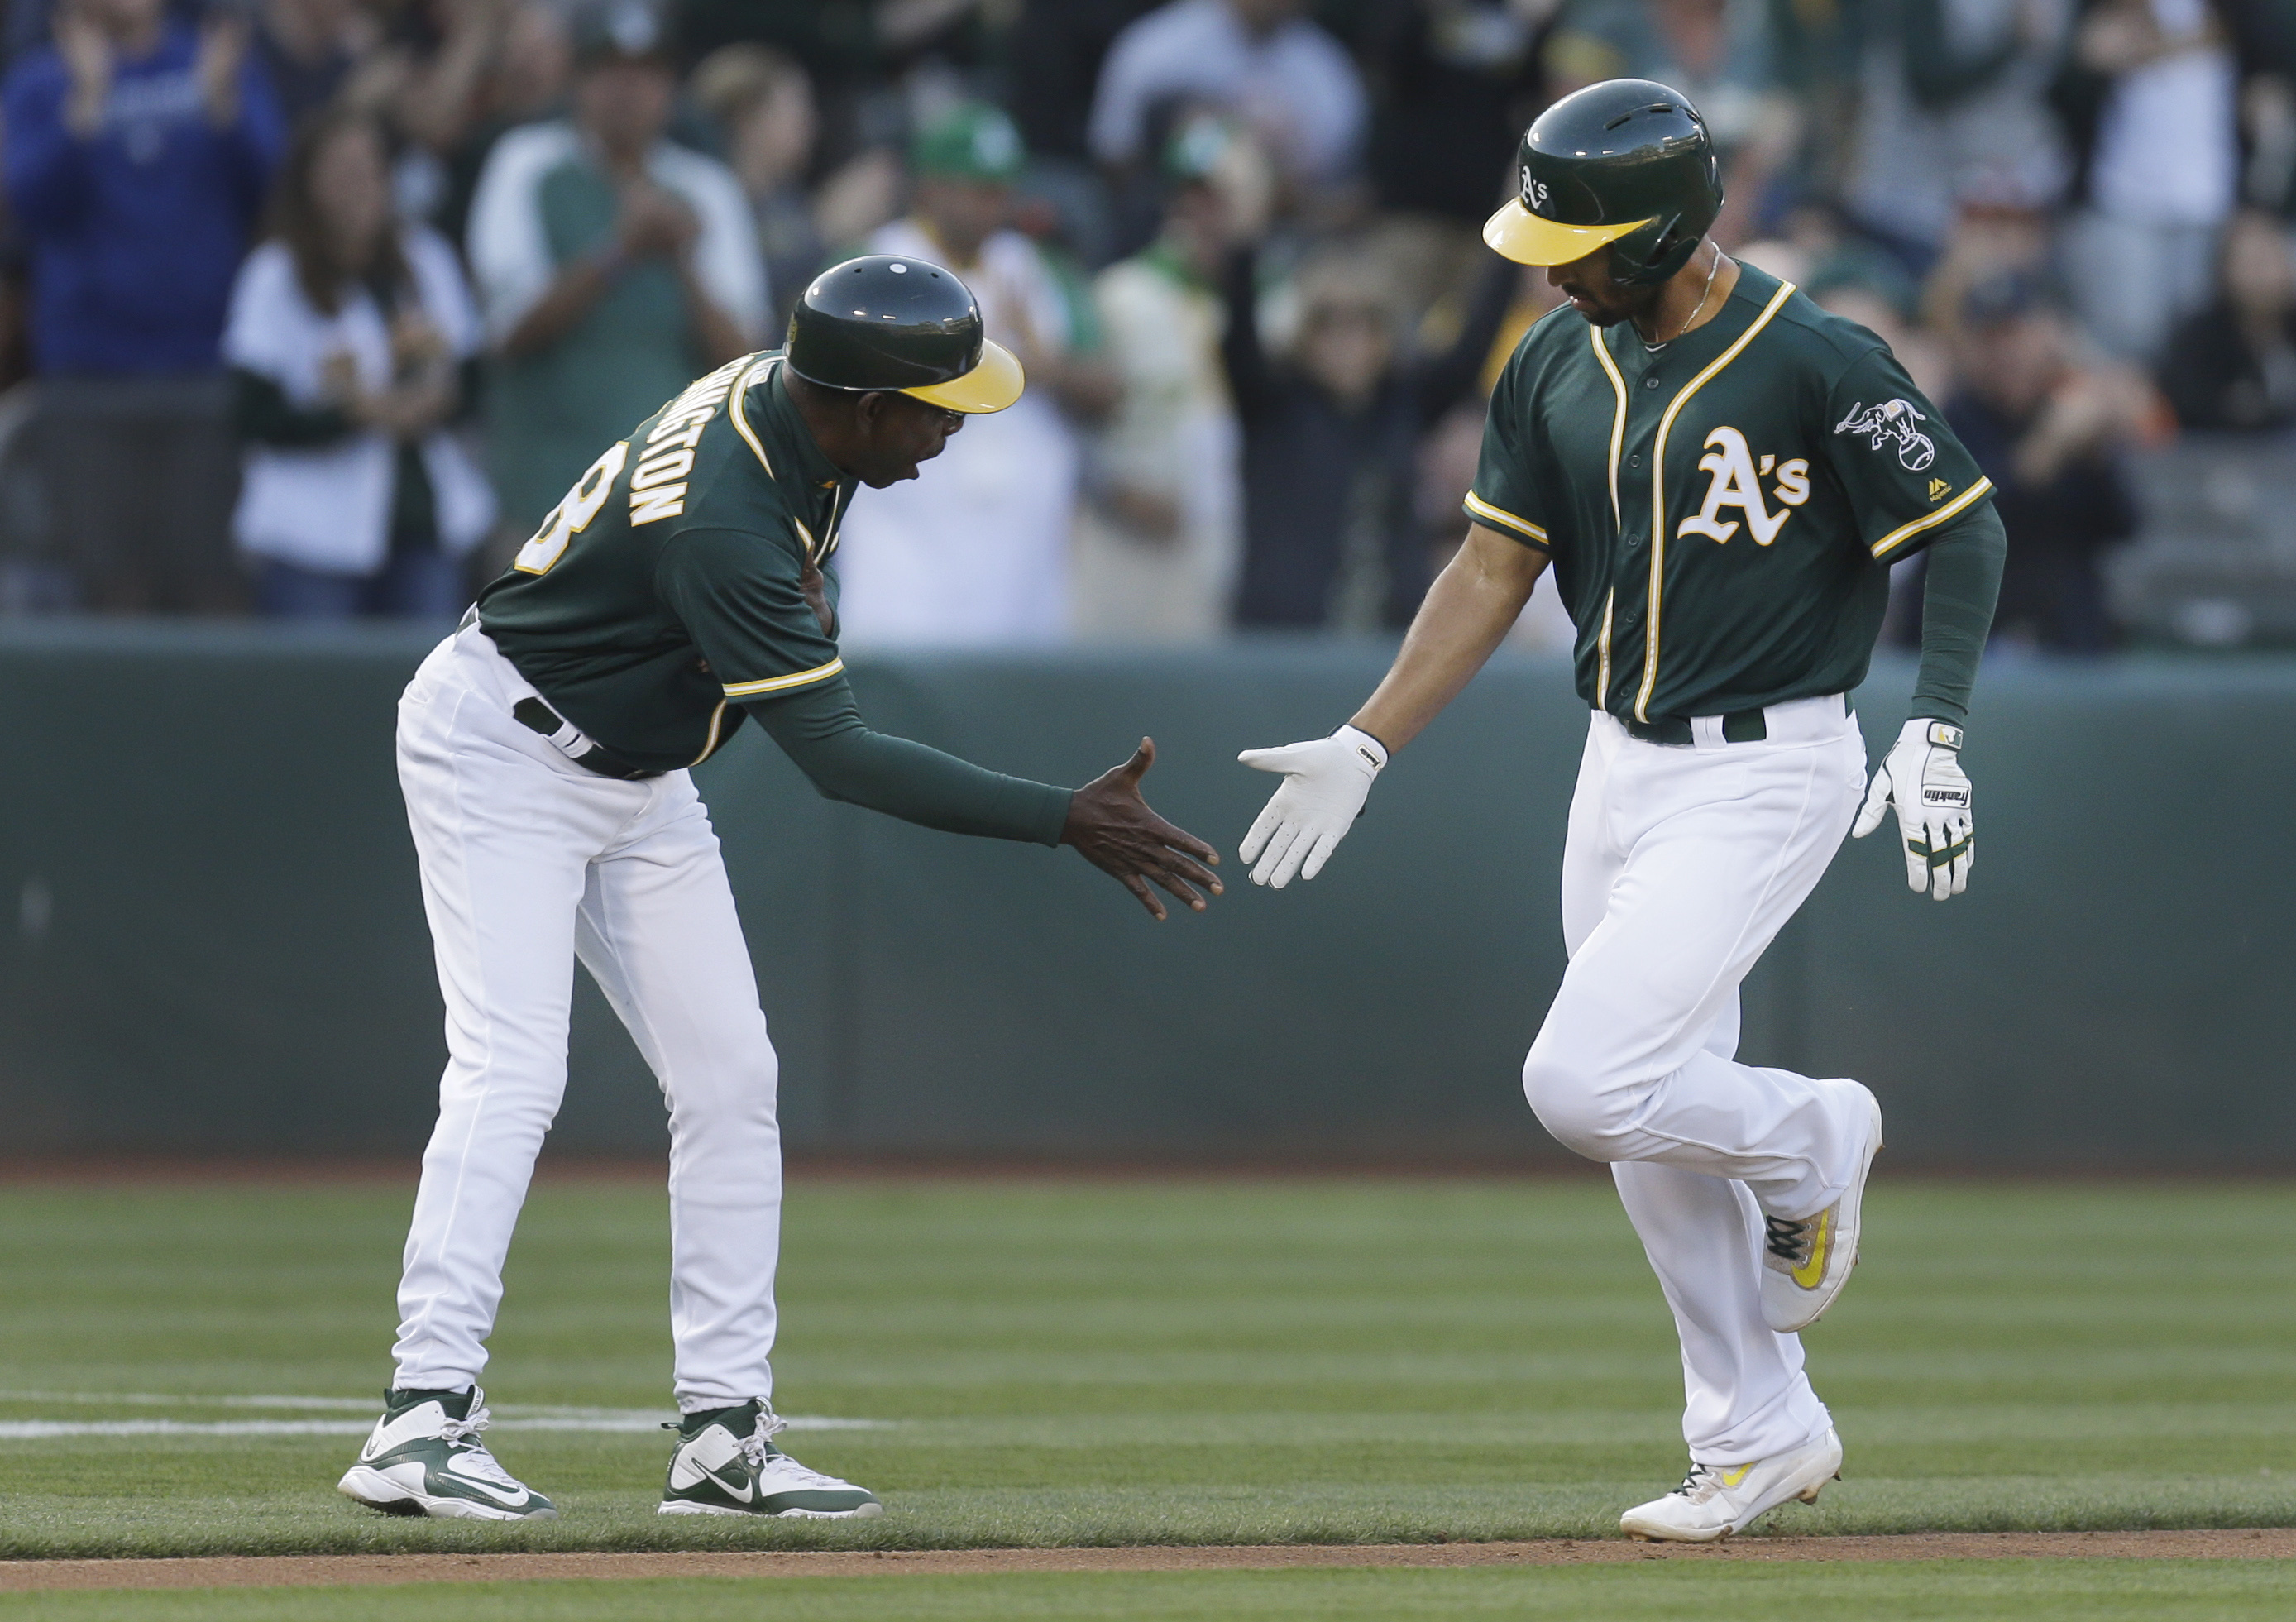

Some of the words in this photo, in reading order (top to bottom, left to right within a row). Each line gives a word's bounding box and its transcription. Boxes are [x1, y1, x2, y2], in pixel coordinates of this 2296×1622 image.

[1519, 165, 1547, 209] A's
[514, 440, 630, 575] 8
[1677, 425, 1810, 547] A's
